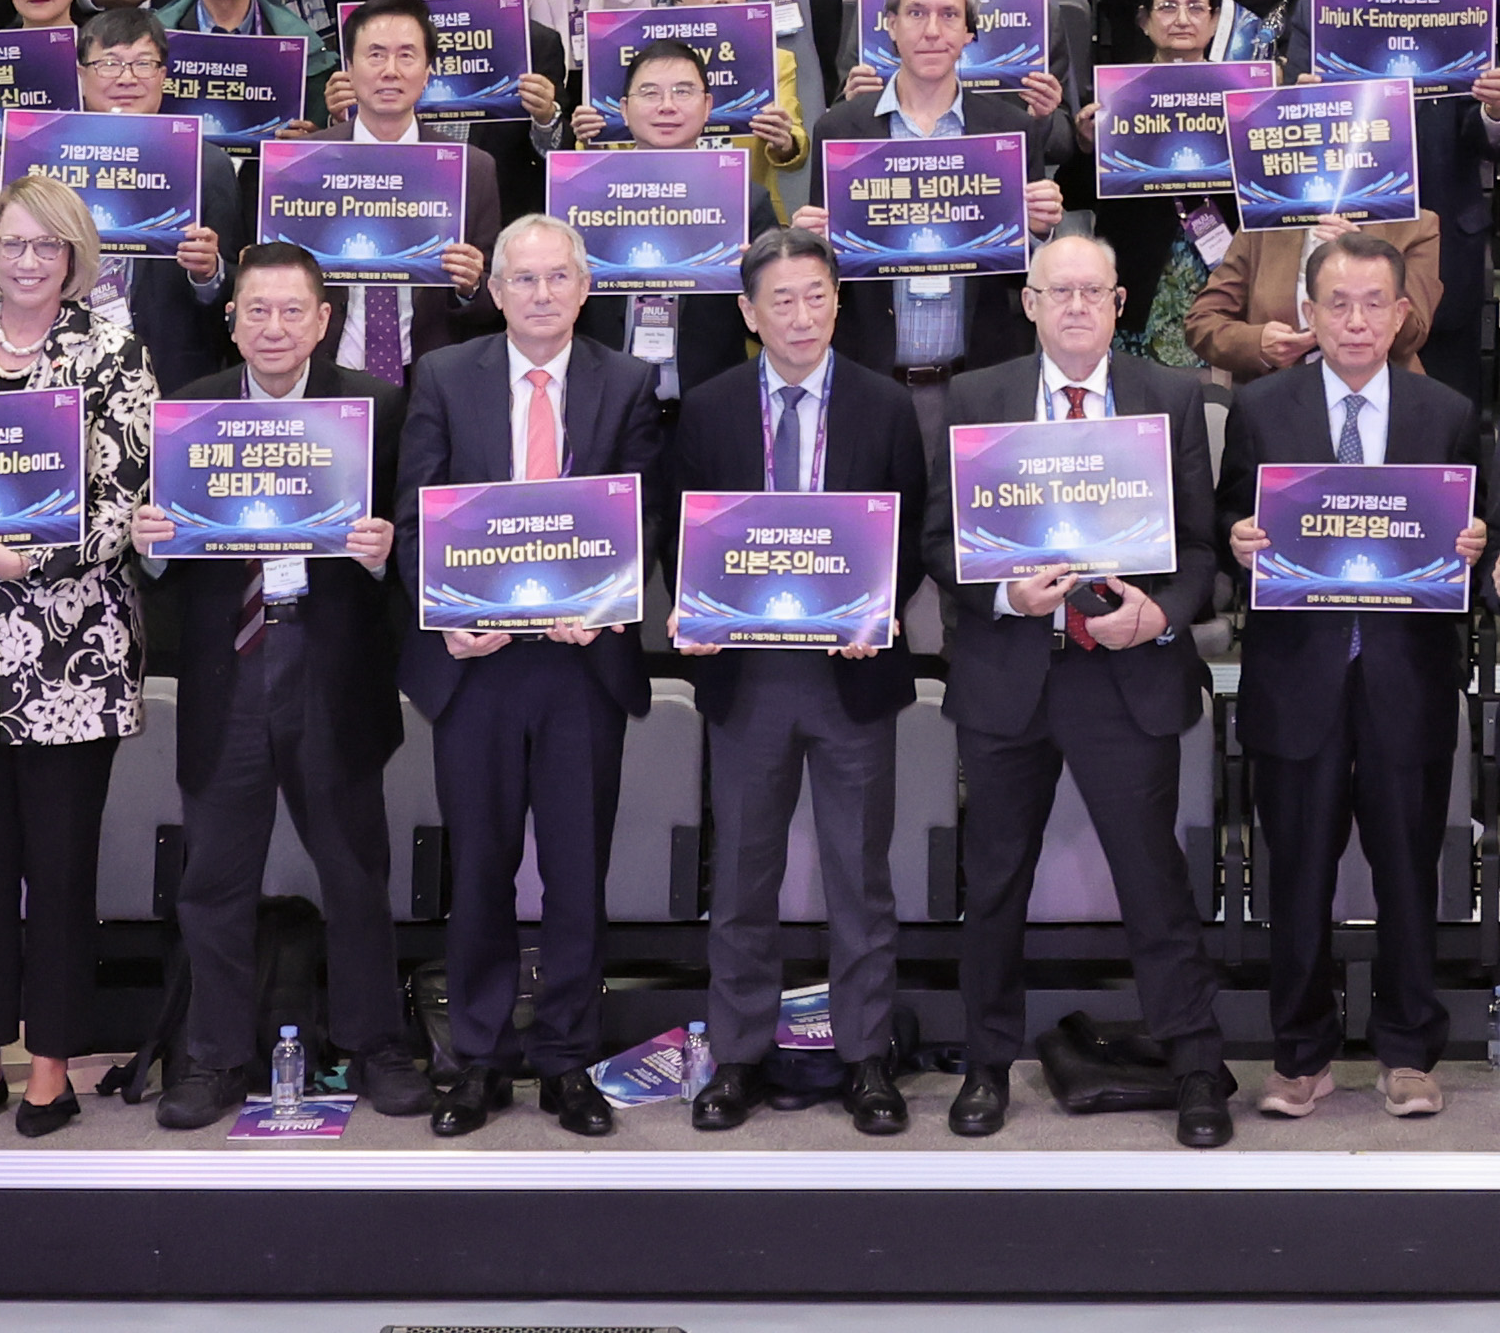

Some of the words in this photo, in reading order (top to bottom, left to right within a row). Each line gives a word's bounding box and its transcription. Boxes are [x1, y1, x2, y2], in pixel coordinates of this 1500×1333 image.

[1318, 5, 1351, 29] Jinju
[1352, 6, 1488, 32] K-Entrepreneurship
[1388, 36, 1419, 51] 이다.
[884, 154, 965, 173] 기업가정신은
[322, 174, 404, 190] 기업가정신은
[849, 177, 912, 201] 실패를
[918, 173, 1002, 199] 넘어서는
[270, 195, 337, 217] Future
[342, 195, 453, 218] Promise이다.
[867, 201, 985, 226] 도전정신이다.
[217, 420, 304, 437] 기업가정신은
[188, 443, 234, 468] 함께
[240, 442, 331, 468] 성장하는
[1018, 454, 1105, 475] 기업가정신은
[206, 472, 313, 497] 생태계이다.
[970, 484, 993, 509] Jo
[998, 483, 1044, 507] Shik
[1048, 477, 1153, 505] Today!이다.
[1321, 494, 1408, 511] 기업가정신은
[486, 514, 574, 535] 기업가정신은
[745, 528, 832, 545] 기업가정신은
[1300, 514, 1426, 539] 인재경영이다.
[445, 536, 617, 567] Innovation!이다.
[724, 550, 850, 575] 인본주의이다.
